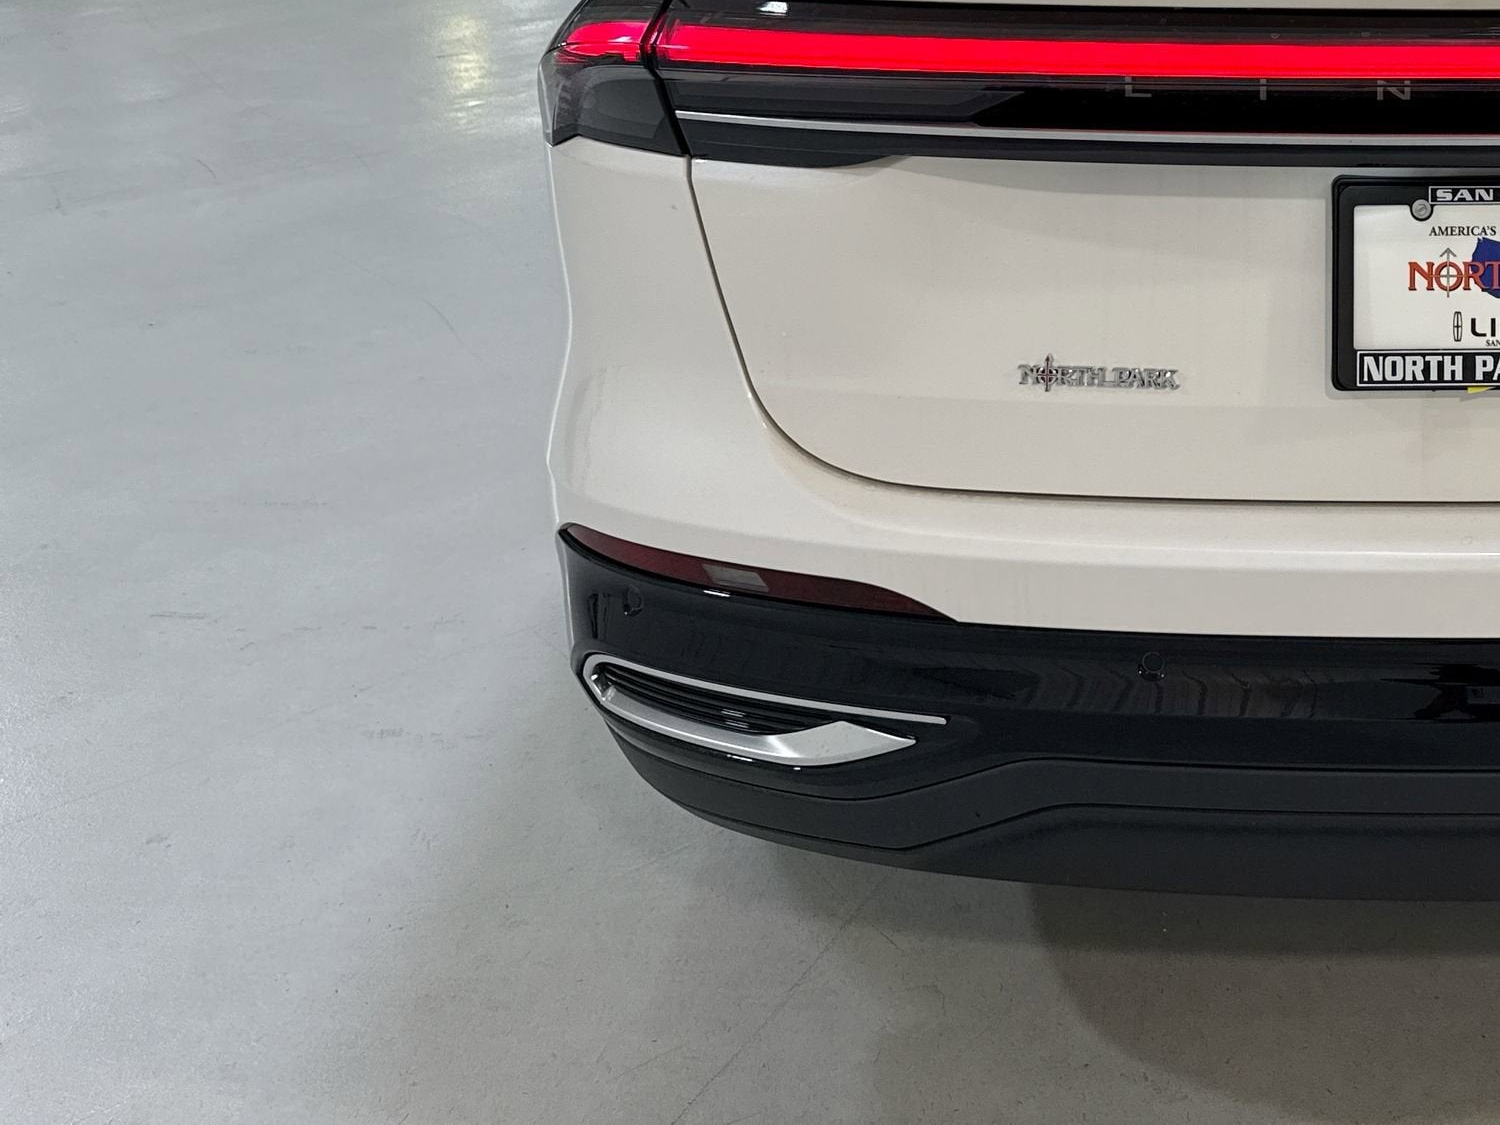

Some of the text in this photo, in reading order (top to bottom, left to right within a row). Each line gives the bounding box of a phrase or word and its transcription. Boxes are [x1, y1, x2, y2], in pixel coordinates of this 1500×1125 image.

[1436, 188, 1494, 202] SAN
[1429, 225, 1497, 237] AMERICA'S
[1017, 363, 1181, 390] NORTH PARK
[1363, 355, 1463, 381] NORTH
